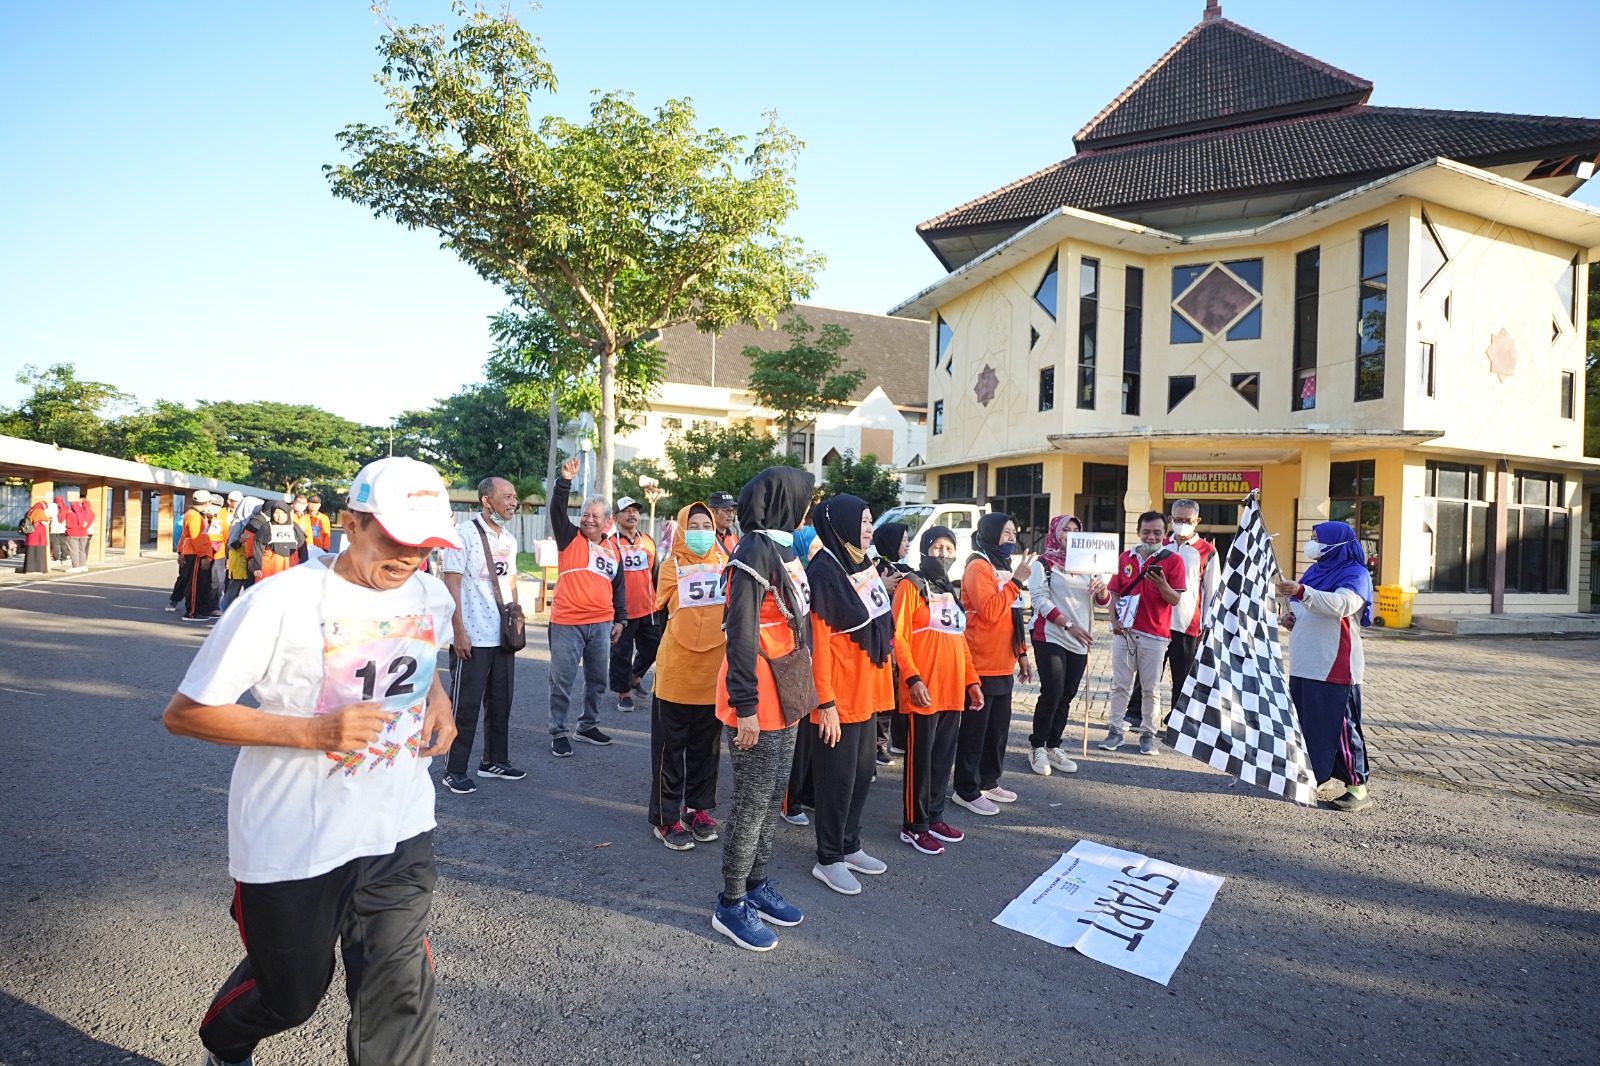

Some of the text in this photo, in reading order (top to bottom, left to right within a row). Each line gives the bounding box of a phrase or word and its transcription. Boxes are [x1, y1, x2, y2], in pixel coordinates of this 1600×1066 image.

[1173, 481, 1250, 493] MODERNA
[1182, 473, 1242, 481] RUANG PETUGAS
[1071, 537, 1116, 551] KELOMPOK
[596, 556, 614, 576] 65
[624, 555, 642, 567] 53
[1091, 553, 1097, 565] 4
[689, 580, 718, 600] 57
[870, 584, 890, 608] 61
[940, 608, 960, 629] 51
[355, 655, 418, 701] 12
[1077, 865, 1180, 952] START
